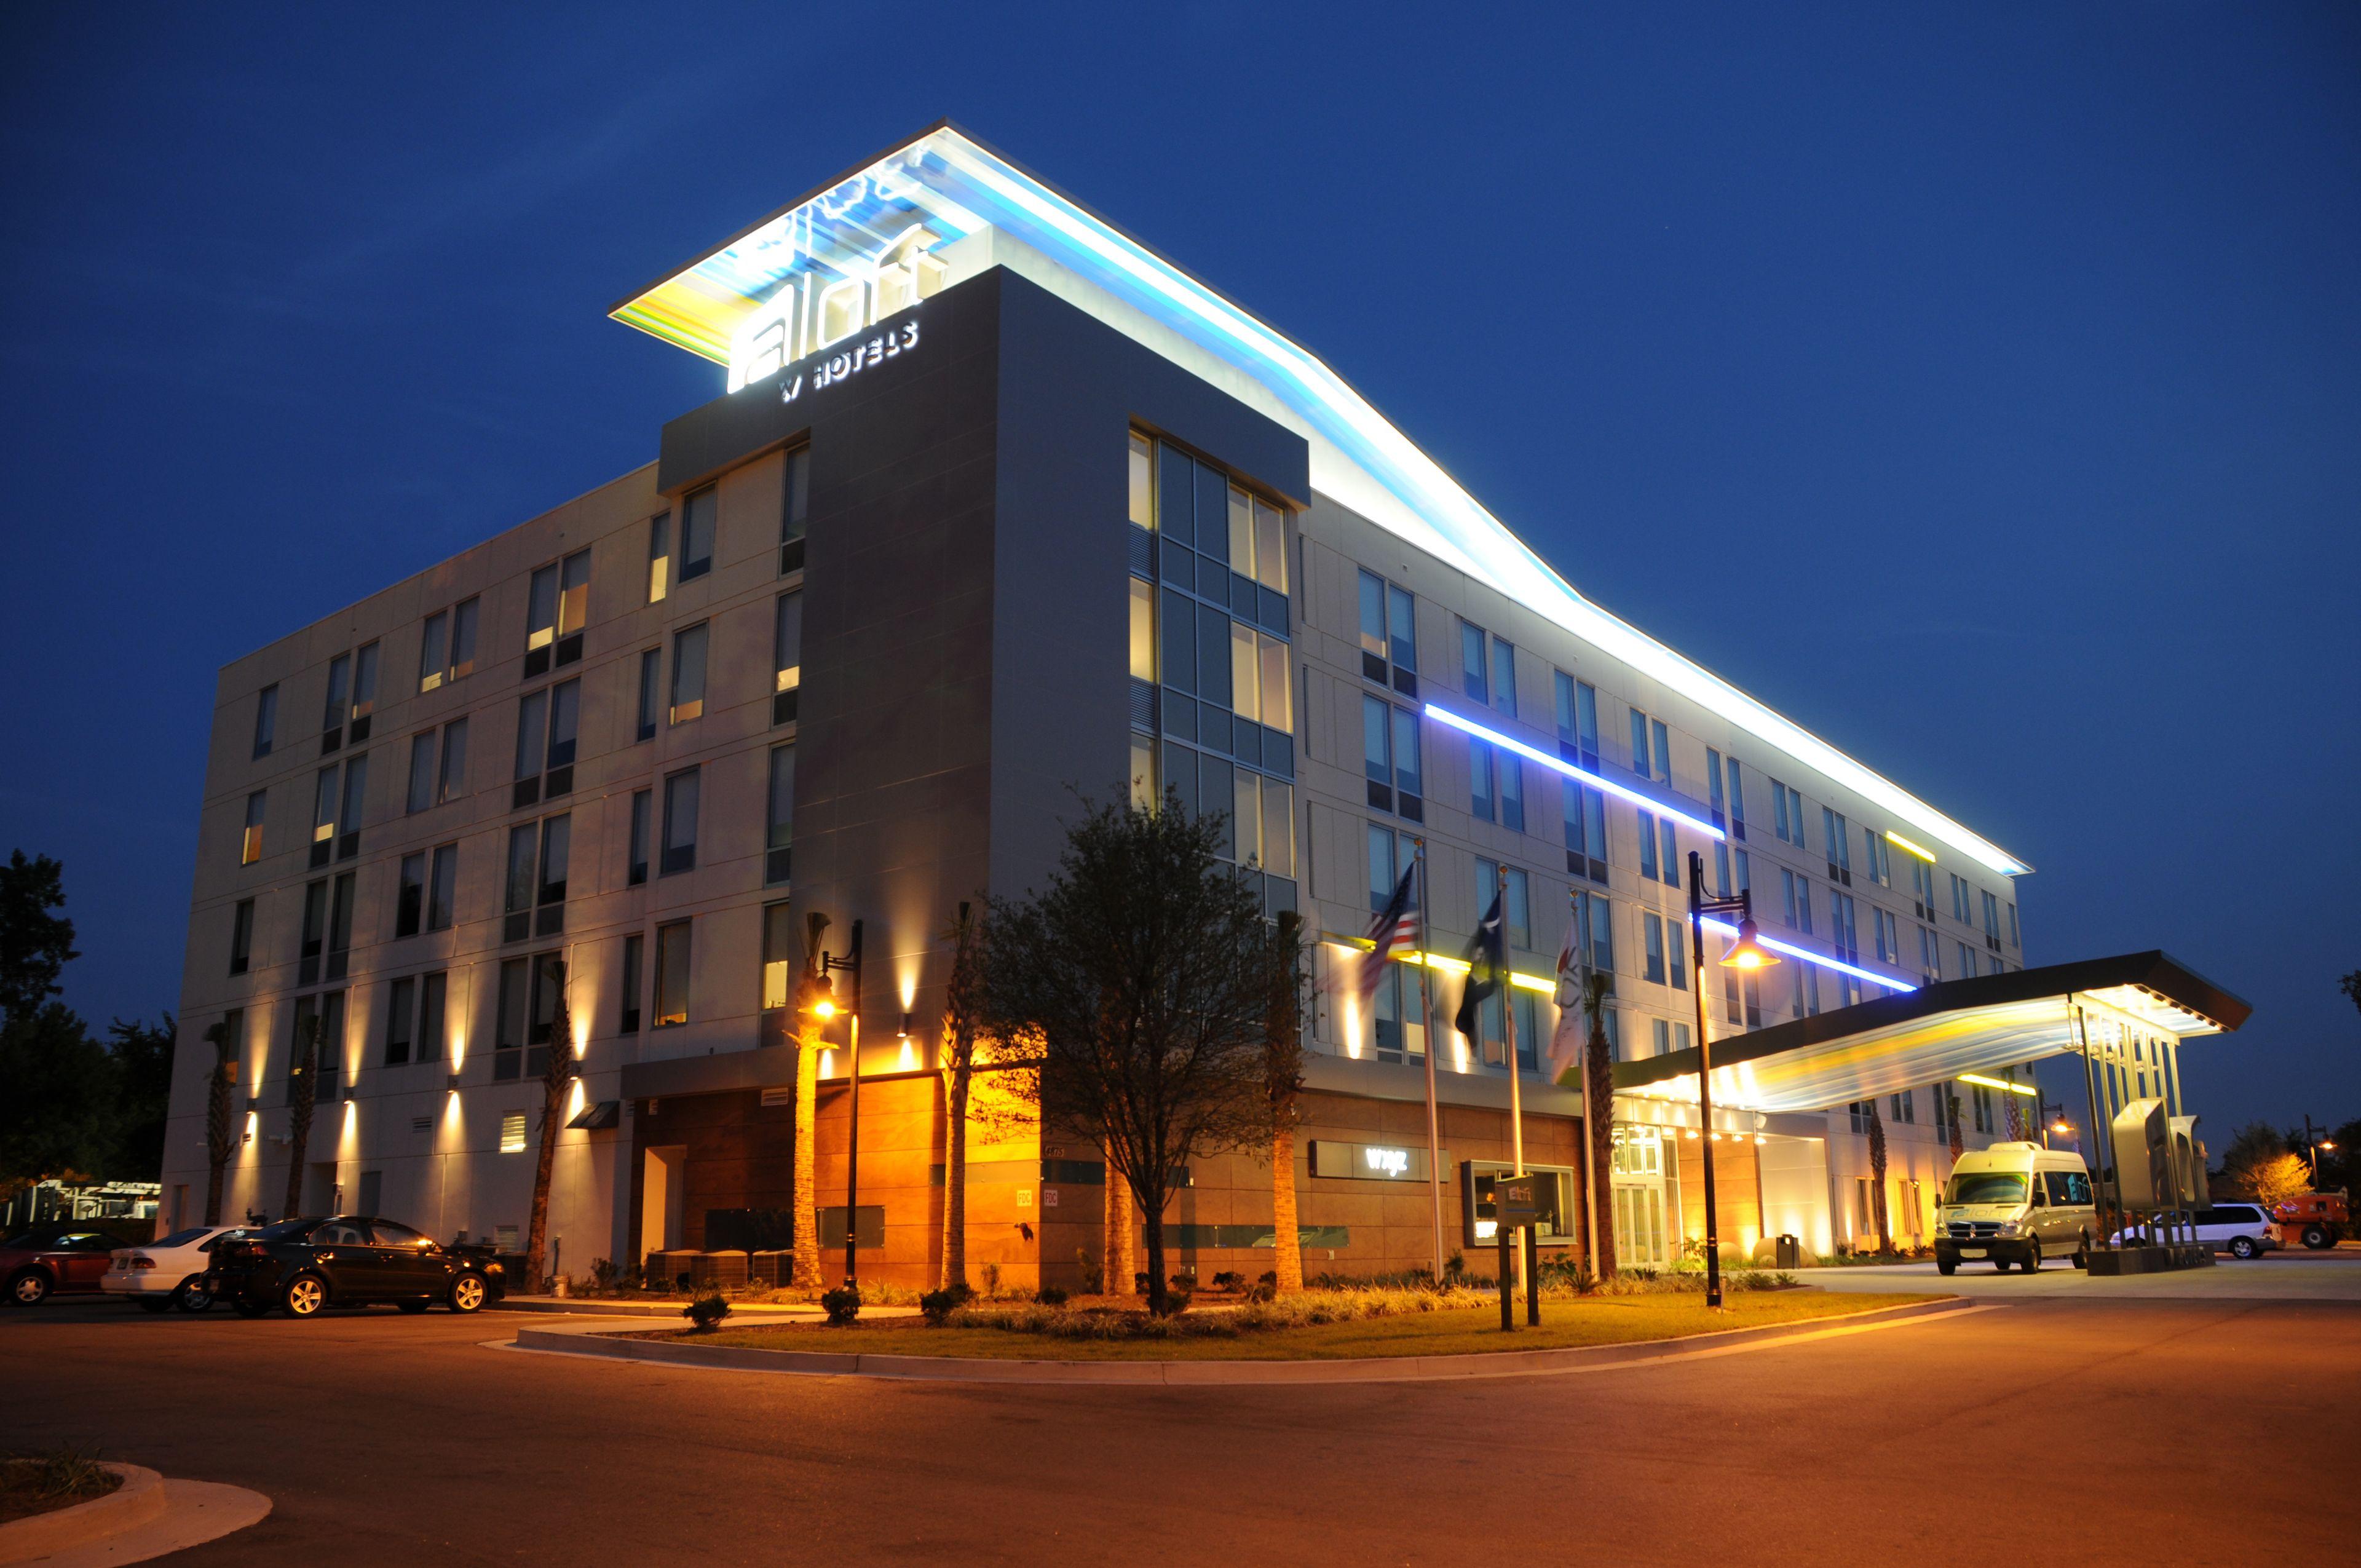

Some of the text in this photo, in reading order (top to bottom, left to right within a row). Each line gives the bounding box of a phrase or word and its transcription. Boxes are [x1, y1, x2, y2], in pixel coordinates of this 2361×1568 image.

[727, 223, 930, 394] aloft
[812, 320, 919, 390] HOTELS
[1018, 1193, 1031, 1203] FDC
[1045, 1193, 1057, 1203] FDC
